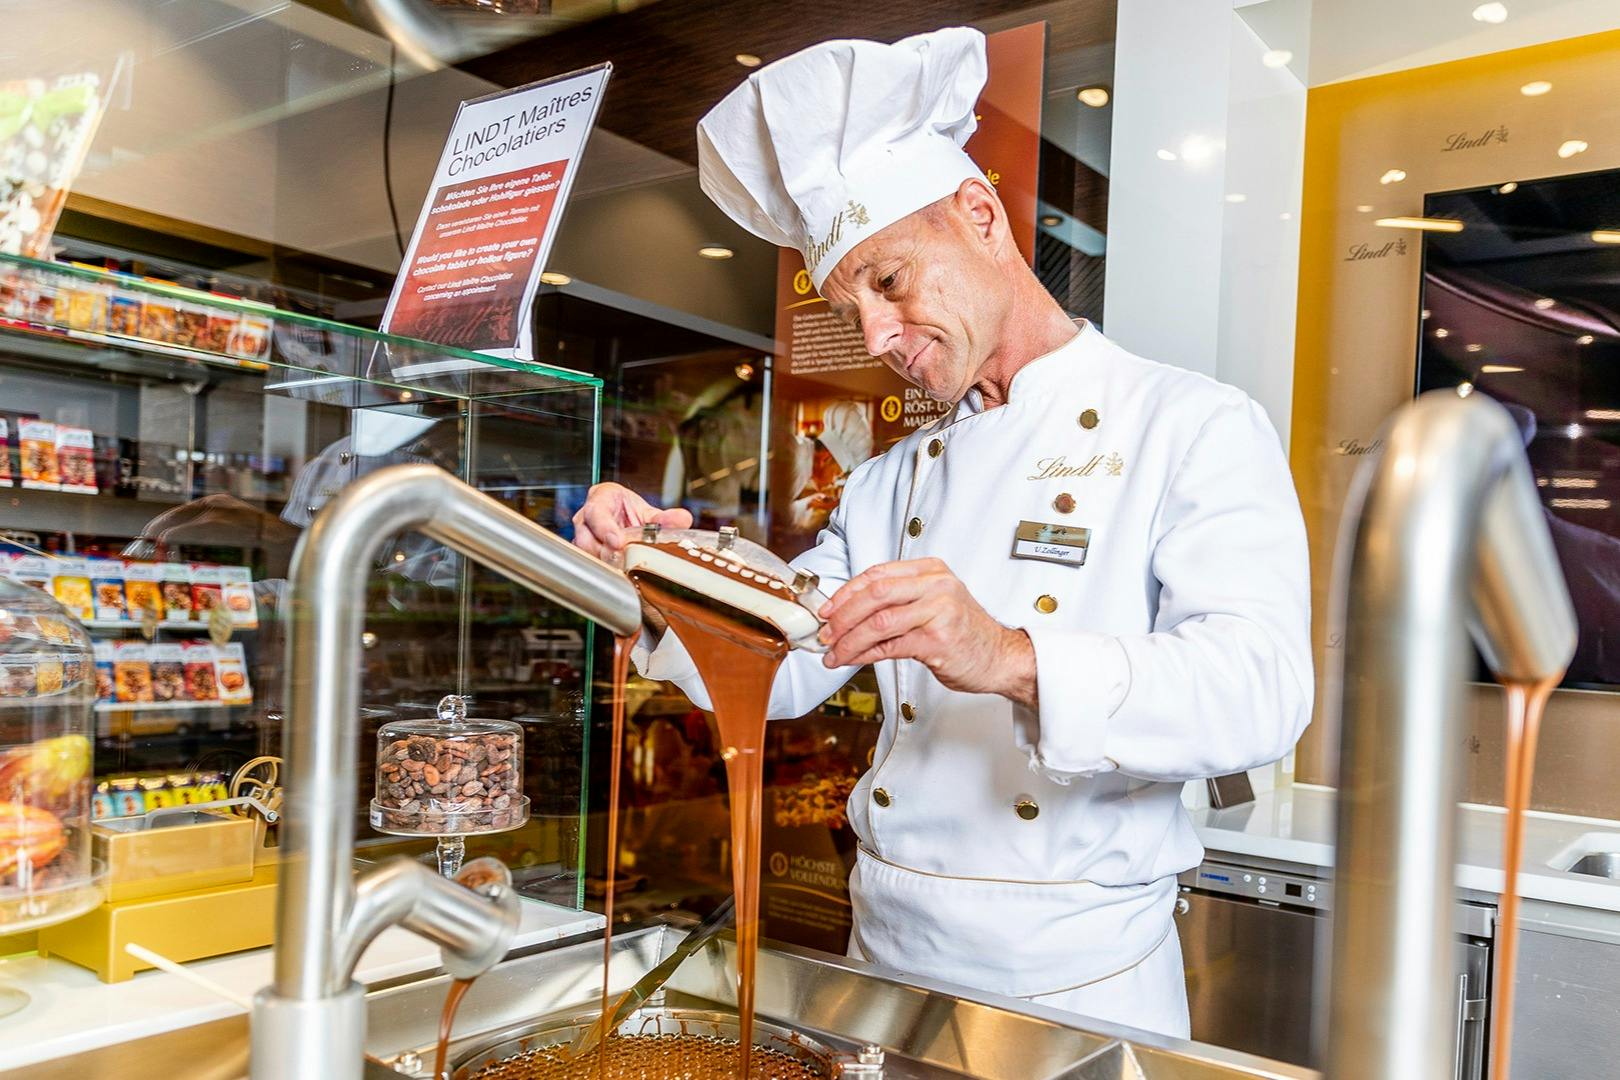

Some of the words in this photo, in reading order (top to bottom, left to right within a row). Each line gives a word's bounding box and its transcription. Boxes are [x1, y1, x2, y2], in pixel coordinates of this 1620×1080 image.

[453, 115, 515, 156] LINDT
[518, 86, 592, 129] Maîtres
[448, 118, 566, 177] Chocolatiers
[1441, 129, 1495, 152] Lindt
[476, 186, 489, 194] Sie
[504, 177, 530, 190] eigene
[472, 196, 489, 207] oder
[413, 263, 447, 276] chocolate
[447, 259, 469, 270] tablet
[469, 258, 477, 266] or
[477, 254, 504, 265] hollow
[503, 248, 533, 261] figure?
[416, 253, 440, 264] Would
[438, 250, 453, 262] you
[453, 247, 467, 258] like
[467, 247, 476, 255] to
[476, 243, 500, 254] create
[499, 240, 519, 251] your
[519, 238, 538, 247] own
[1344, 241, 1395, 262] Lindt
[905, 388, 922, 400] EIN
[904, 401, 935, 414] RÖST-
[937, 401, 954, 412] UN
[1026, 454, 1105, 481] Lindt
